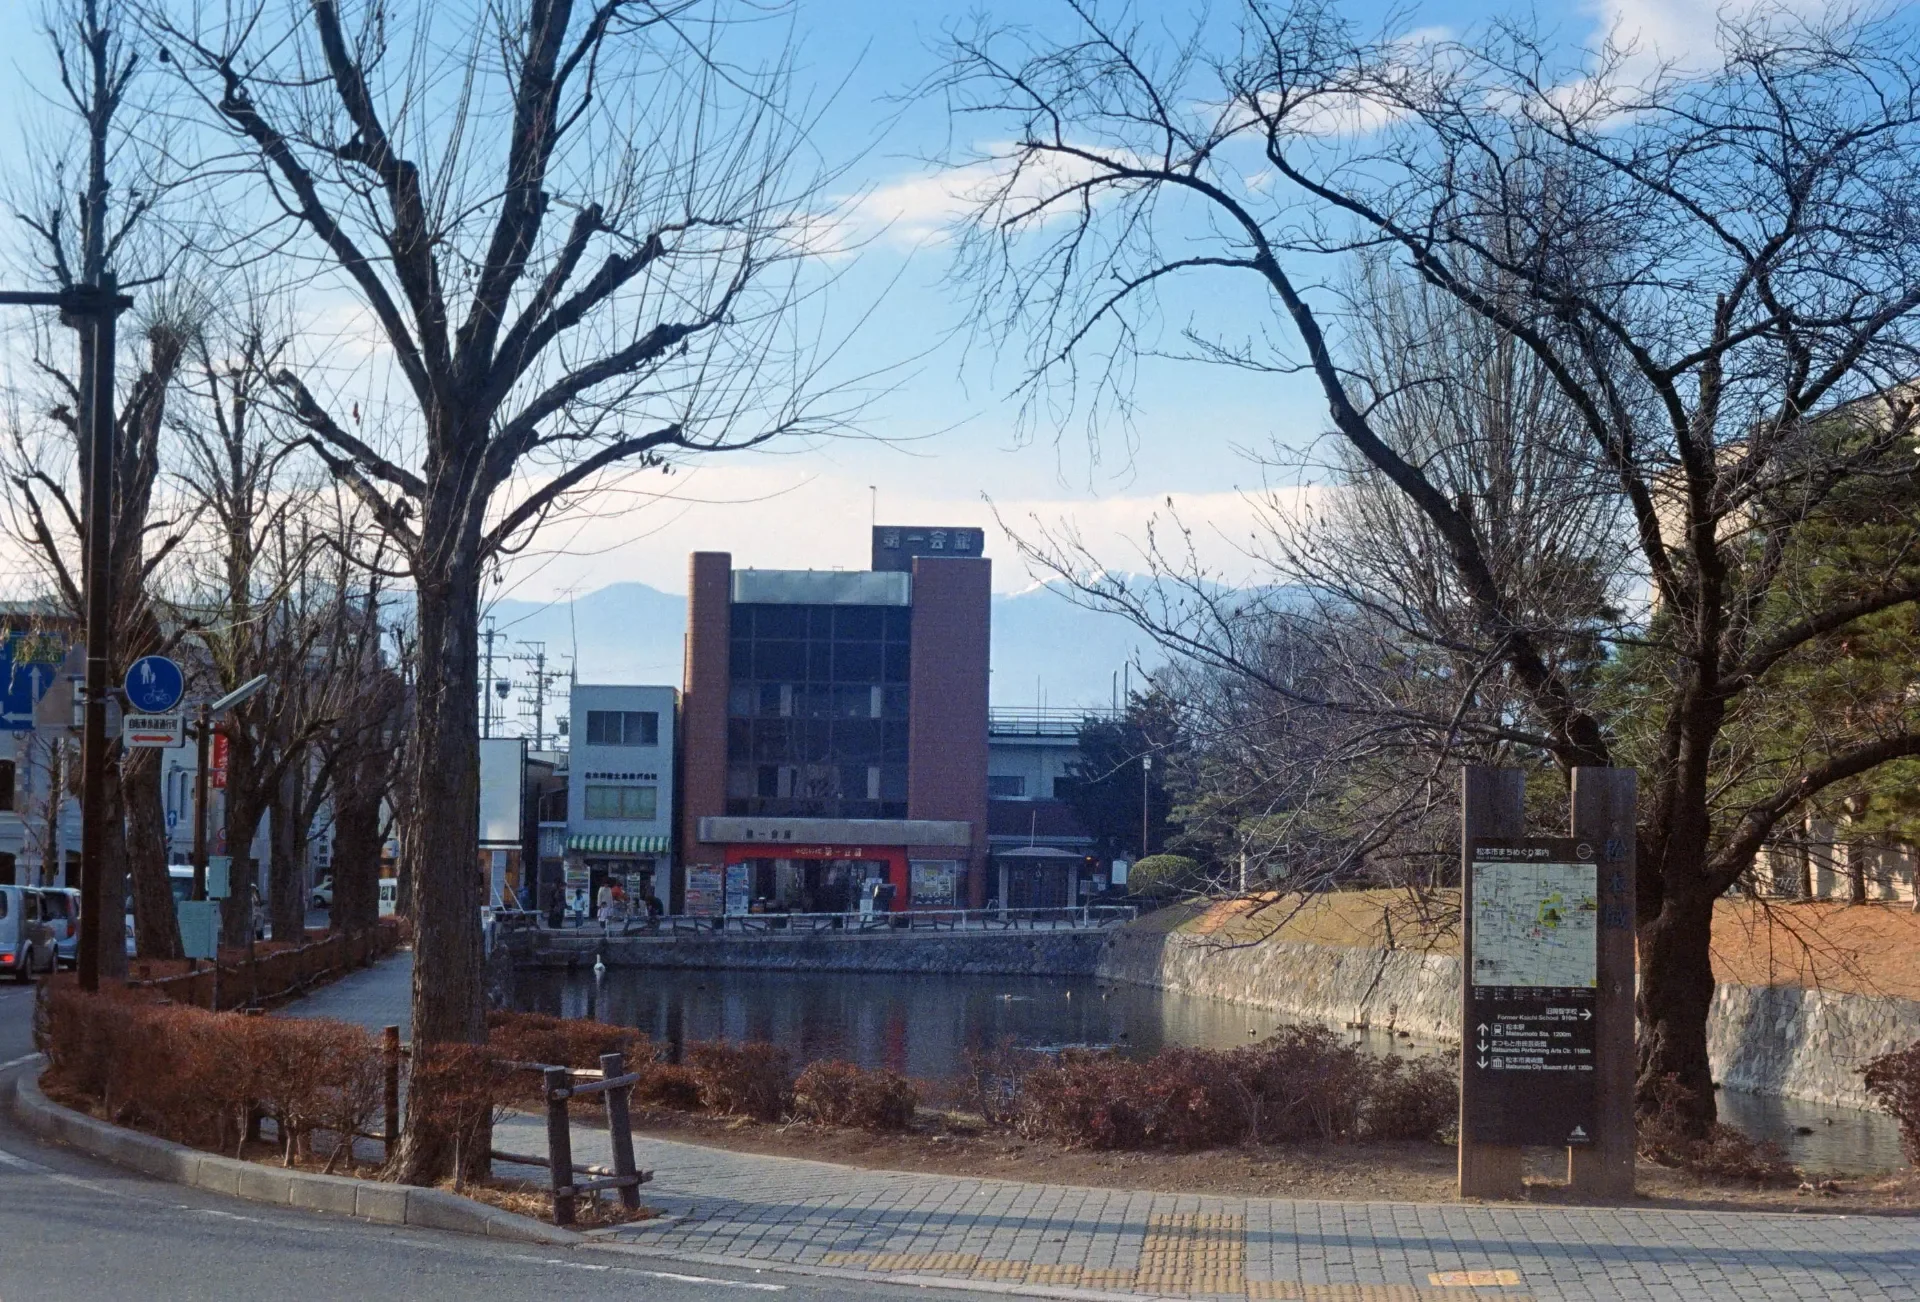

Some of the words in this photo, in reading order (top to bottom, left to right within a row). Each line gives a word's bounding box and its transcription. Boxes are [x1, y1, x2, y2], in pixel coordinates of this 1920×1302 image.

[1476, 847, 1550, 857] 松本市まちめぐり案内
[1521, 1047, 1550, 1055] Performing
